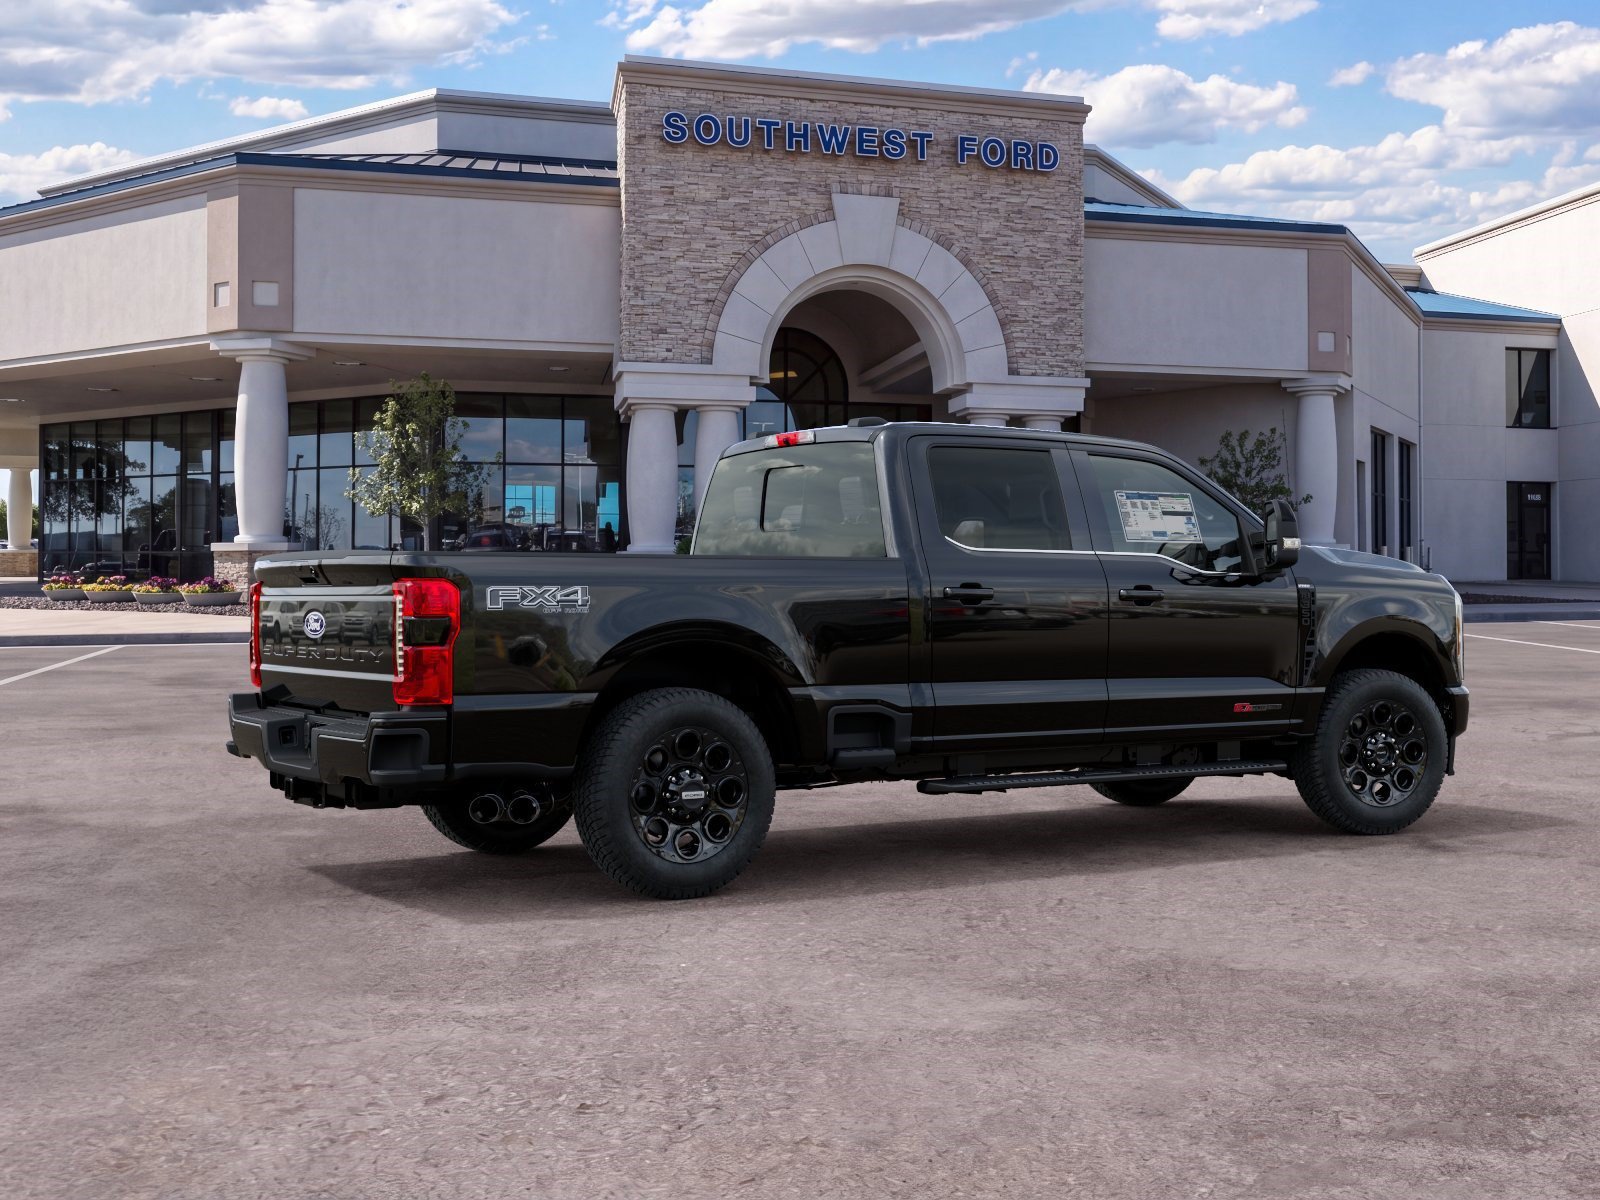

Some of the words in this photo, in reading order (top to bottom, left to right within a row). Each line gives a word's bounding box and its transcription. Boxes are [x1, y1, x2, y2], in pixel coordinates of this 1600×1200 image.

[662, 111, 934, 161] SOUTHWEST
[957, 134, 1060, 172] FORD
[486, 586, 590, 610] FX4
[263, 644, 321, 659] SUPER
[325, 647, 384, 663] DUTY
